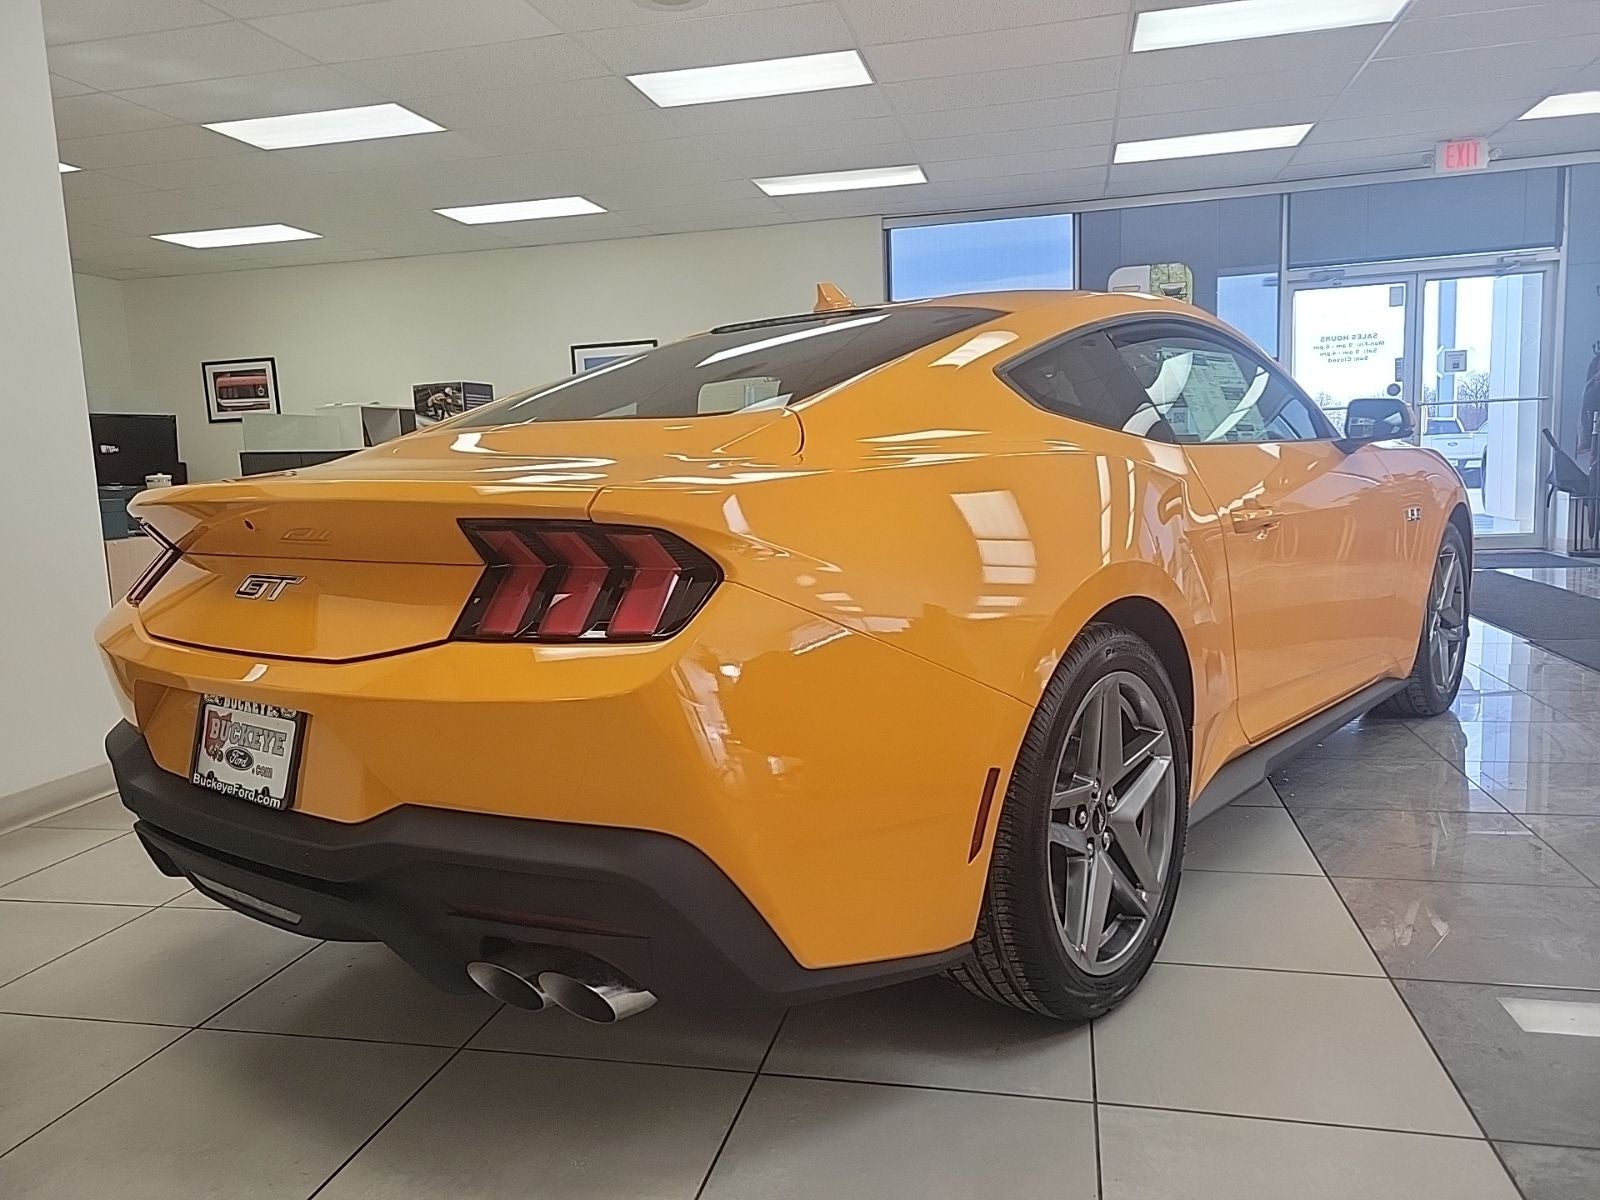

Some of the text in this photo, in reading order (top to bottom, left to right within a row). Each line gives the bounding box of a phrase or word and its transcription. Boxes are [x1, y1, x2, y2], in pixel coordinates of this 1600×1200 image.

[1446, 142, 1478, 168] EXIT
[234, 573, 307, 601] GT
[209, 718, 287, 756] BUCKEYE
[228, 748, 250, 768] Ford
[193, 773, 281, 808] BuckeyeFord.com
